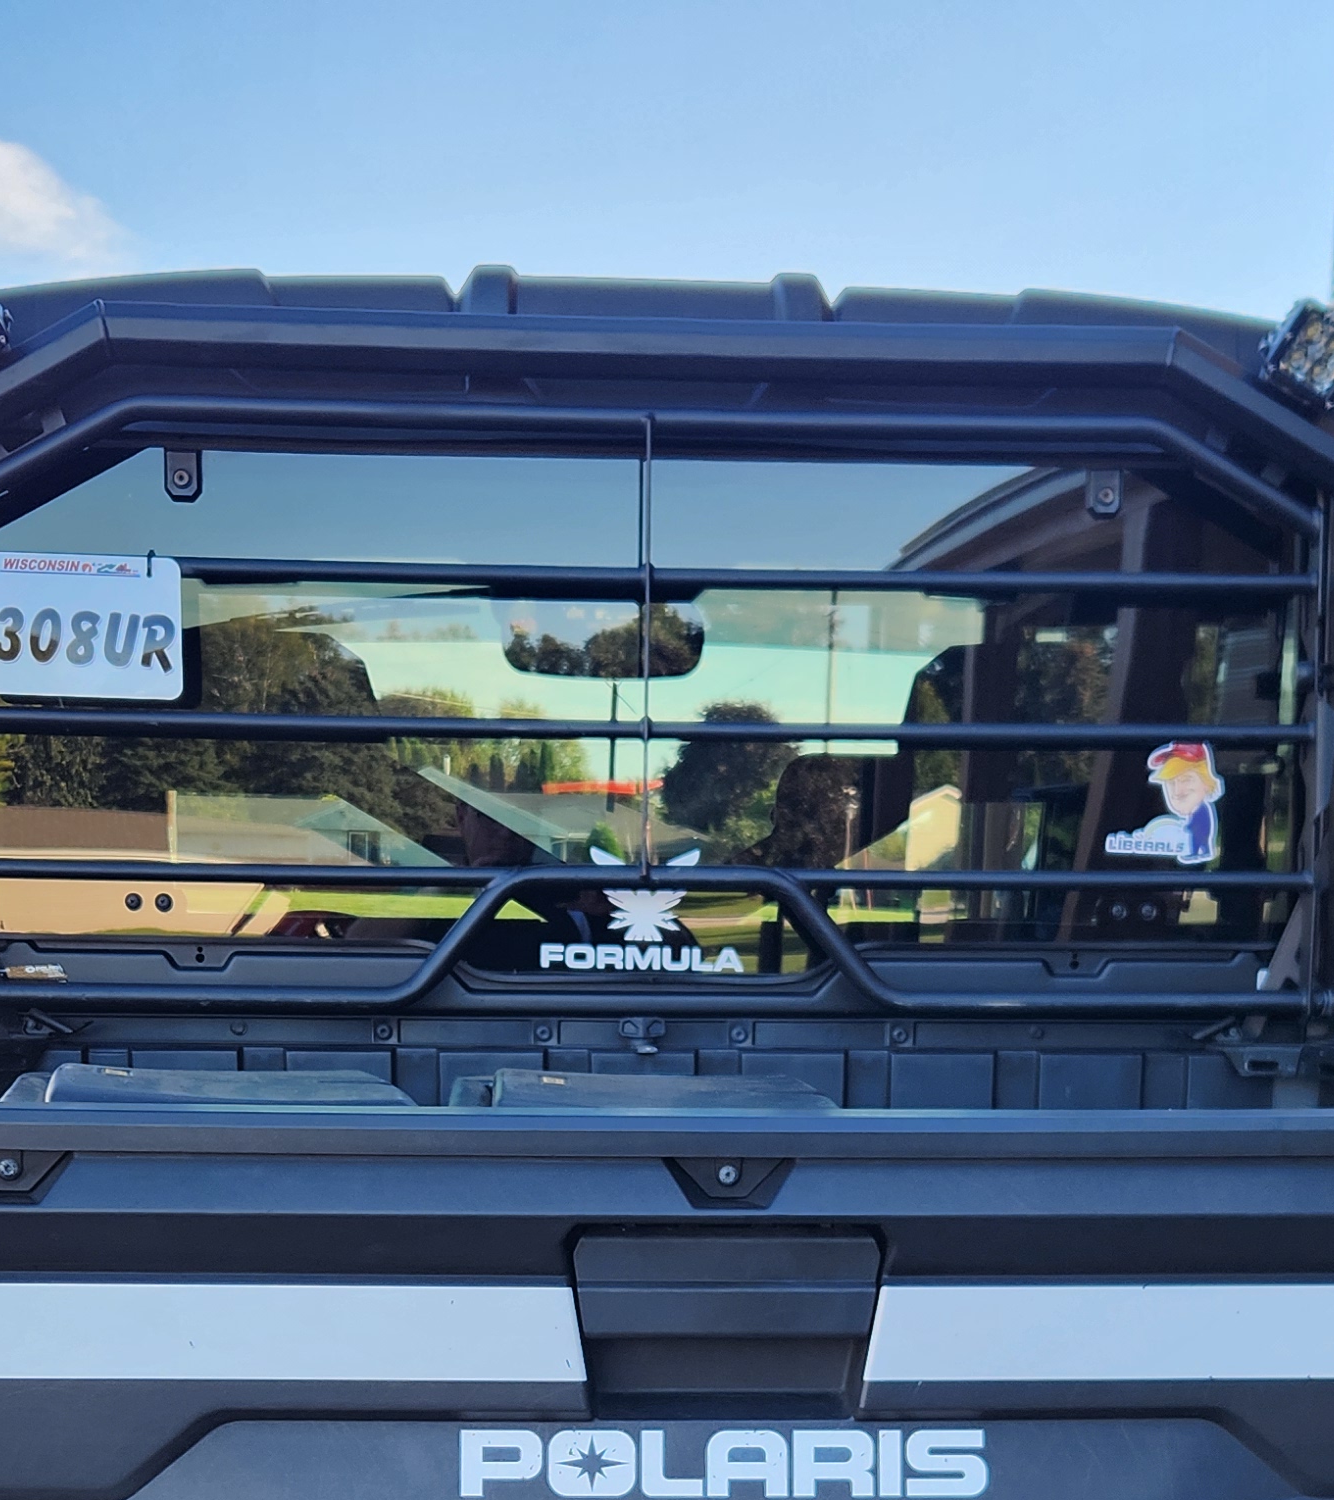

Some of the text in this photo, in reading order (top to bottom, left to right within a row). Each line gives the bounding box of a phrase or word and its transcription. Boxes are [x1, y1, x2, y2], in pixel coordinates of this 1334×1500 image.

[3, 557, 81, 572] WISCONSIN
[539, 943, 744, 973] FORMULA
[459, 1429, 989, 1498] POLARIS
